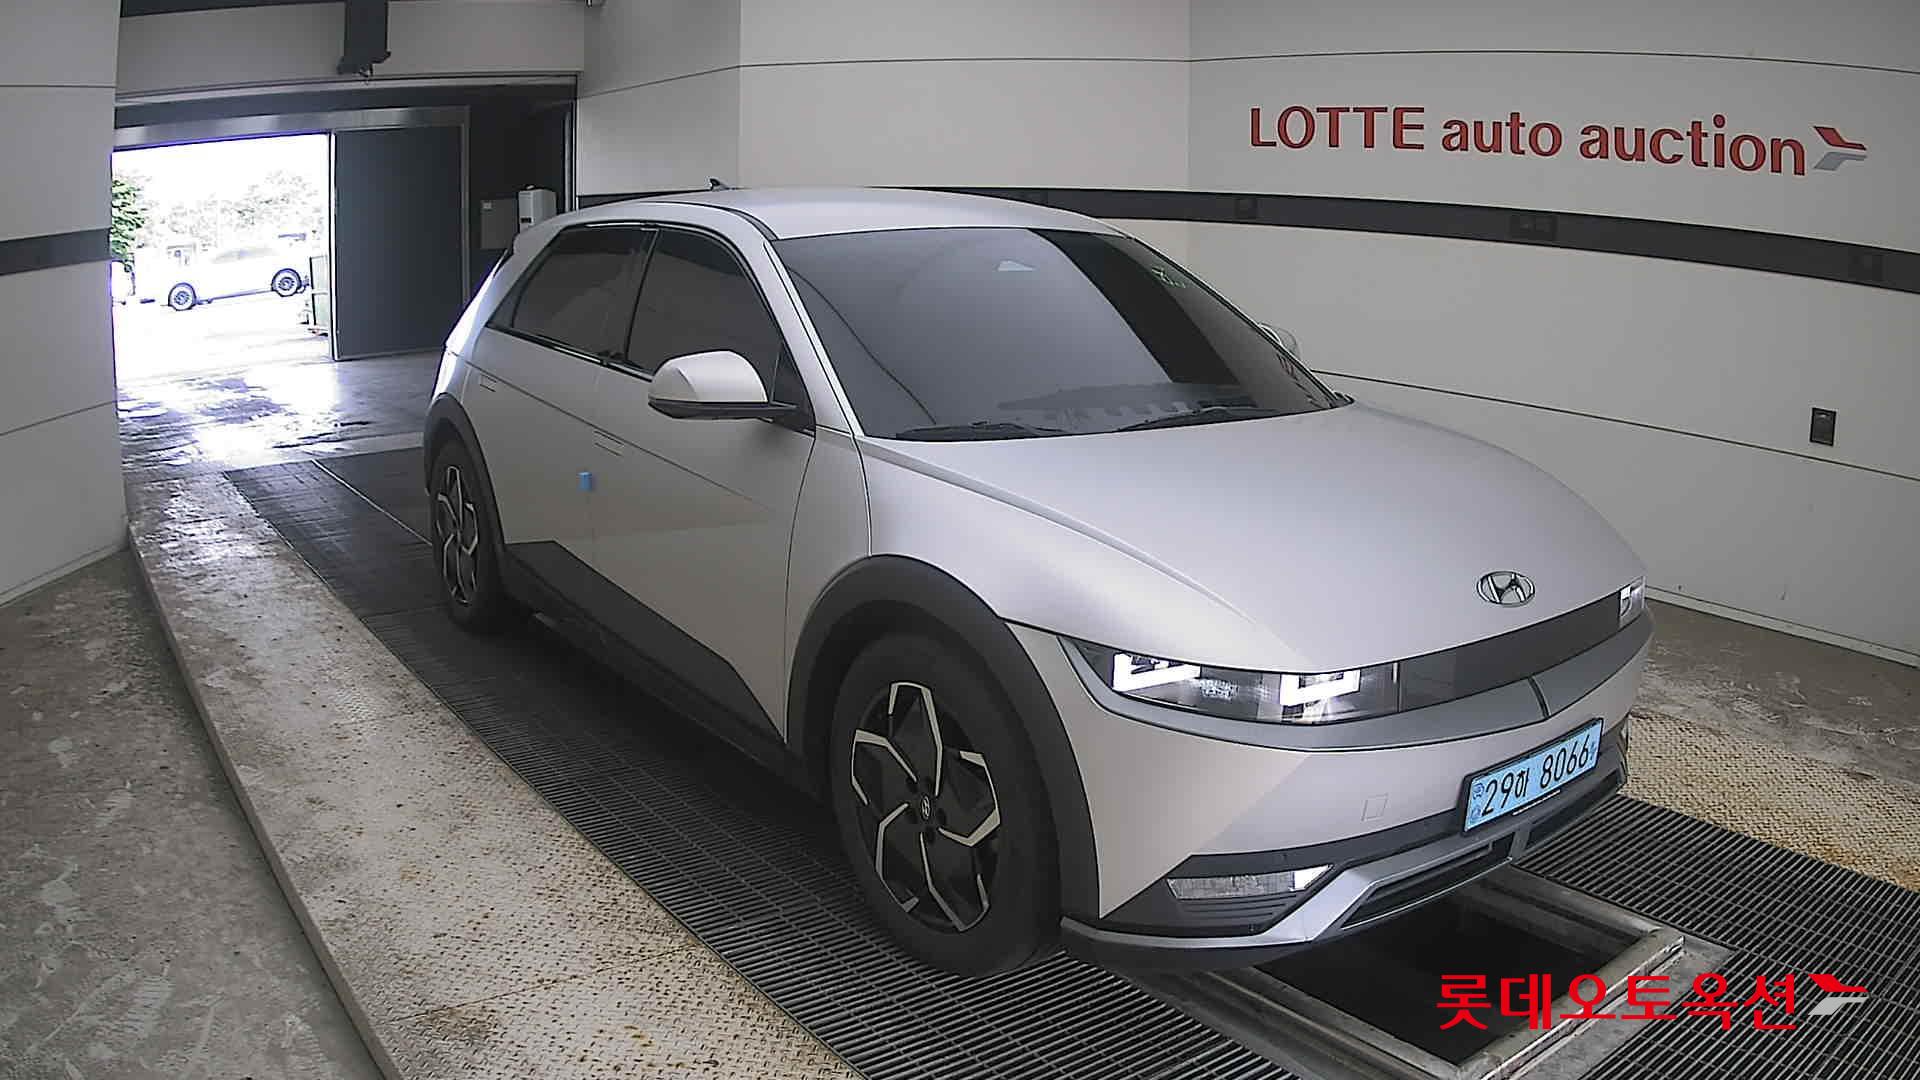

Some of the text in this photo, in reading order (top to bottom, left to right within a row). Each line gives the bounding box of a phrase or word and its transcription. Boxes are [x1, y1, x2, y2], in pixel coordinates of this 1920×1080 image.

[1250, 106, 1806, 176] LOTTE auto auction
[1482, 767, 1530, 817] 29하
[1540, 734, 1590, 789] 8066
